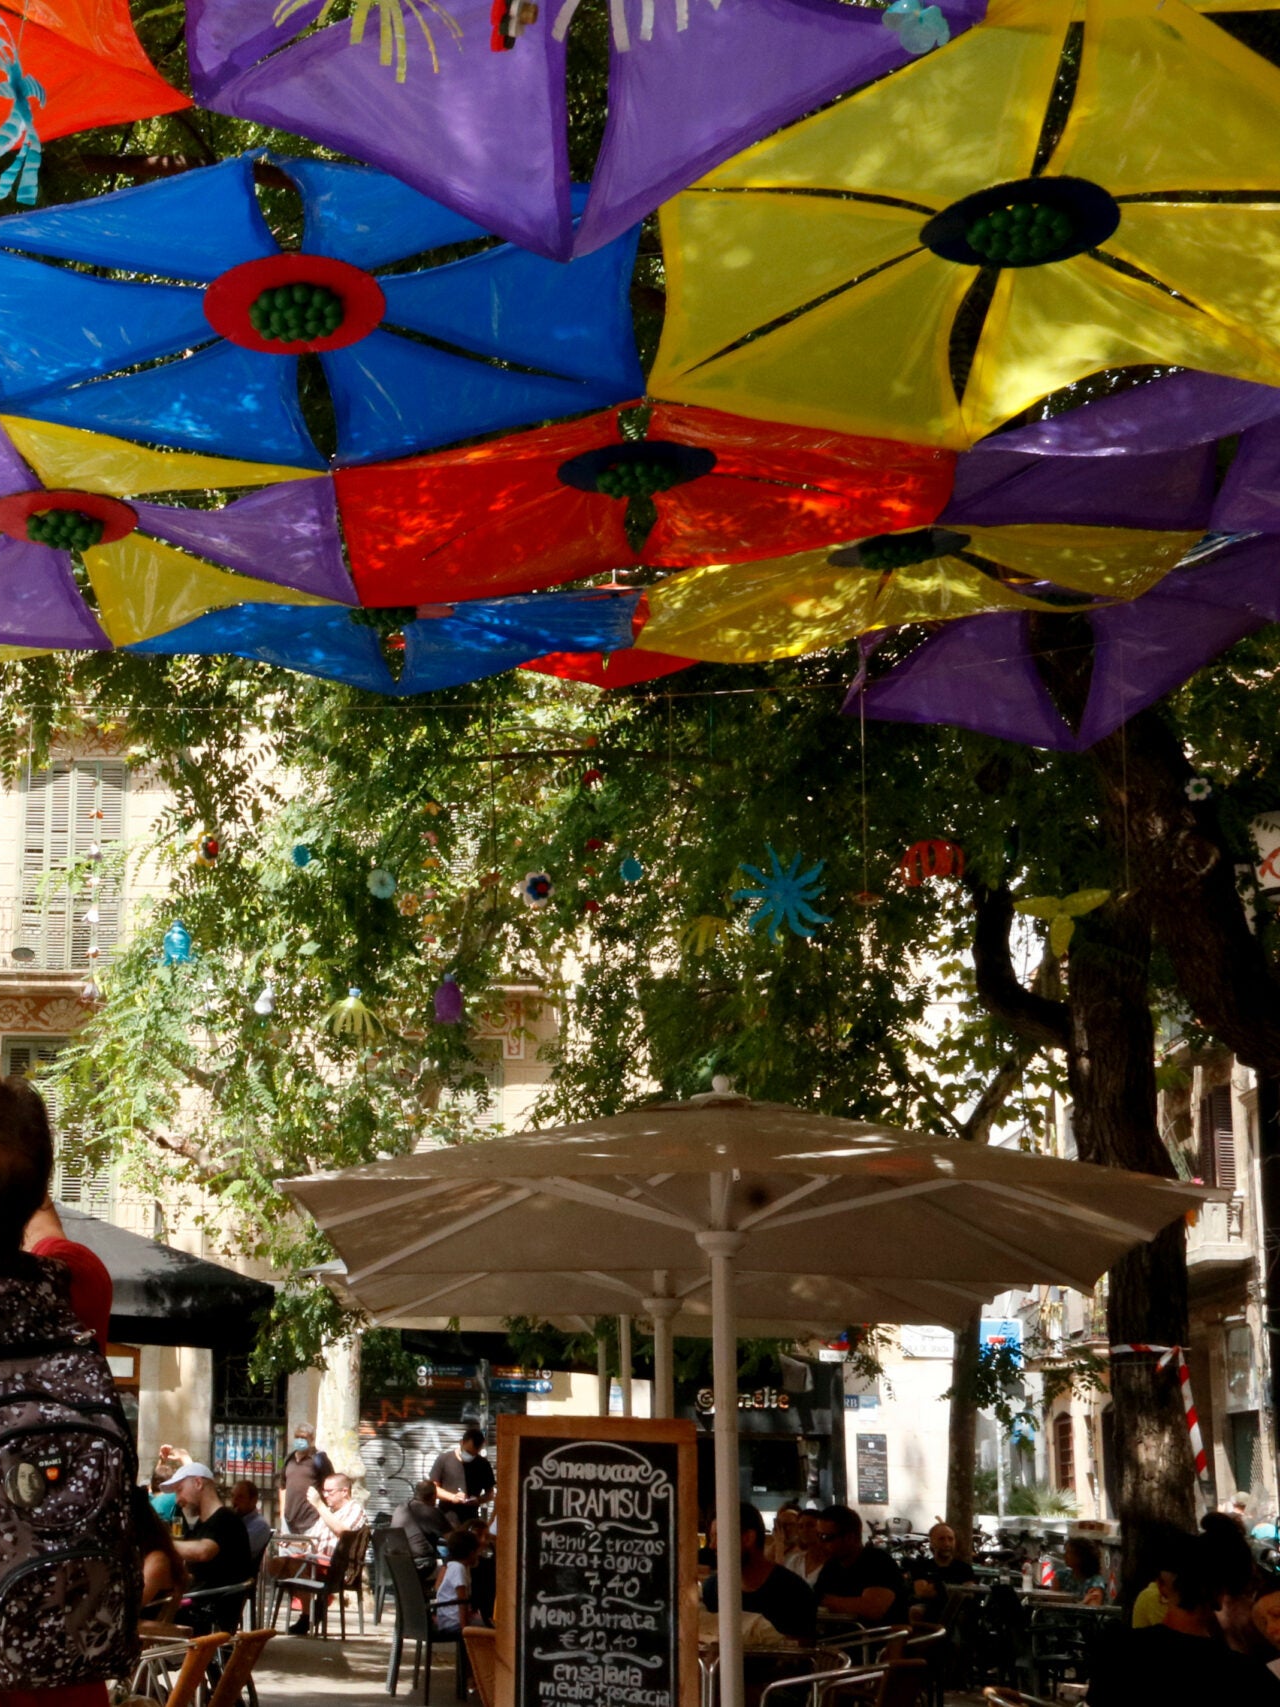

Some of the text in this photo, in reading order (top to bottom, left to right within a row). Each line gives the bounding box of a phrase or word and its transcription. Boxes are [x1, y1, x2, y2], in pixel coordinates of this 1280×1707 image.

[542, 1485, 652, 1520] TIRAMISU
[587, 1531, 603, 1552] 2
[606, 1538, 666, 1555] trozos
[539, 1551, 588, 1569] pizza
[603, 1553, 653, 1573] agua
[584, 1570, 640, 1598] 7,40
[579, 1603, 658, 1631] Burrata
[553, 1662, 642, 1686] ensalada
[539, 1681, 595, 1699] media
